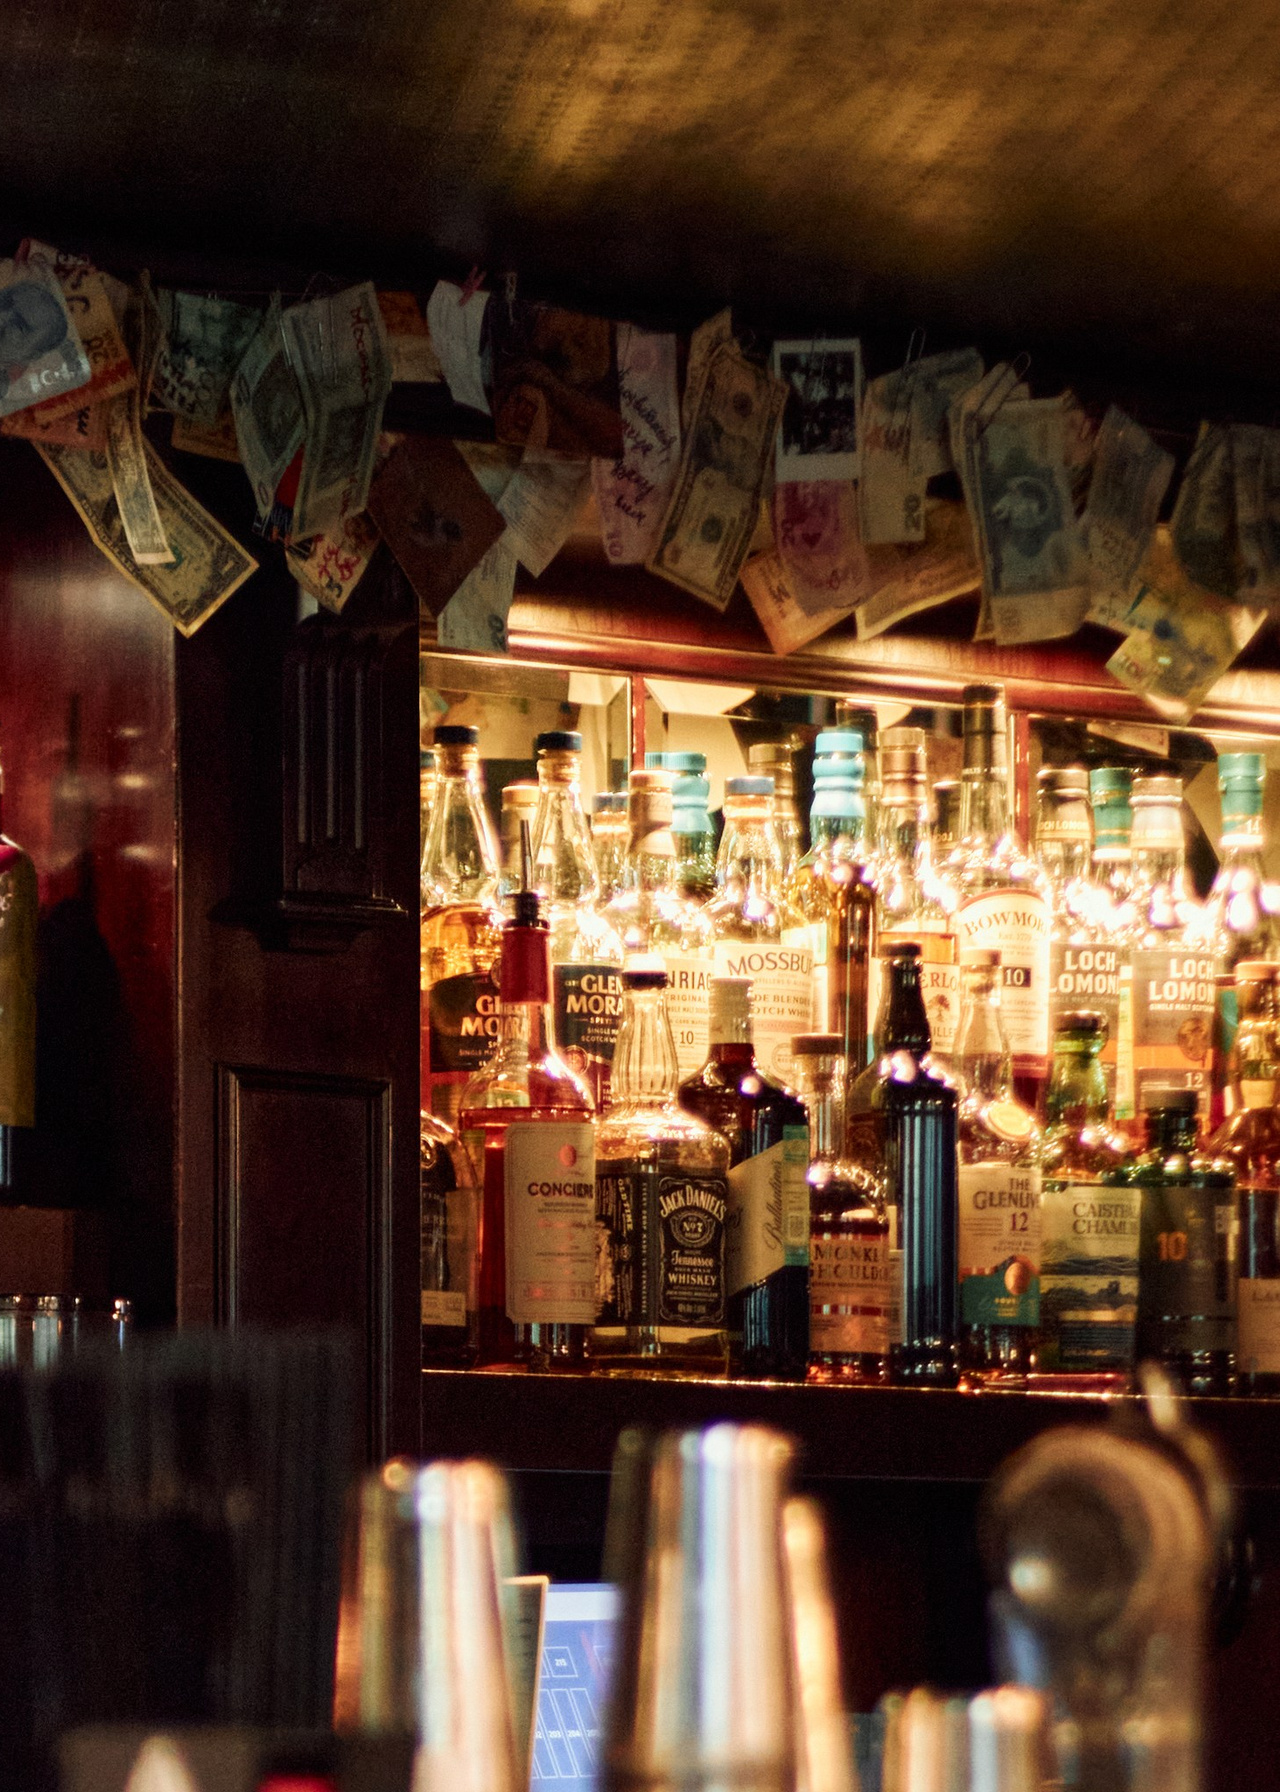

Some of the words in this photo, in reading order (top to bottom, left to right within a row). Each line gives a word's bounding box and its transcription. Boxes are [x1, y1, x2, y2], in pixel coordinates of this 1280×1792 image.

[1065, 950, 1116, 971] LOCH
[1170, 958, 1214, 979] LOCH
[580, 974, 623, 995] GLEN
[1004, 968, 1025, 986] 10
[679, 1030, 694, 1045] 10
[1185, 1072, 1204, 1088] 12
[1009, 1177, 1031, 1190] THE
[659, 1188, 685, 1218] JACK
[685, 1184, 726, 1221] DANIEL'S
[1010, 1212, 1028, 1231] 12
[1157, 1231, 1188, 1260] 10
[671, 1249, 714, 1267] Tennessee
[668, 1273, 717, 1287] WHISKEY
[549, 1730, 562, 1739] 203
[568, 1730, 581, 1738] 204
